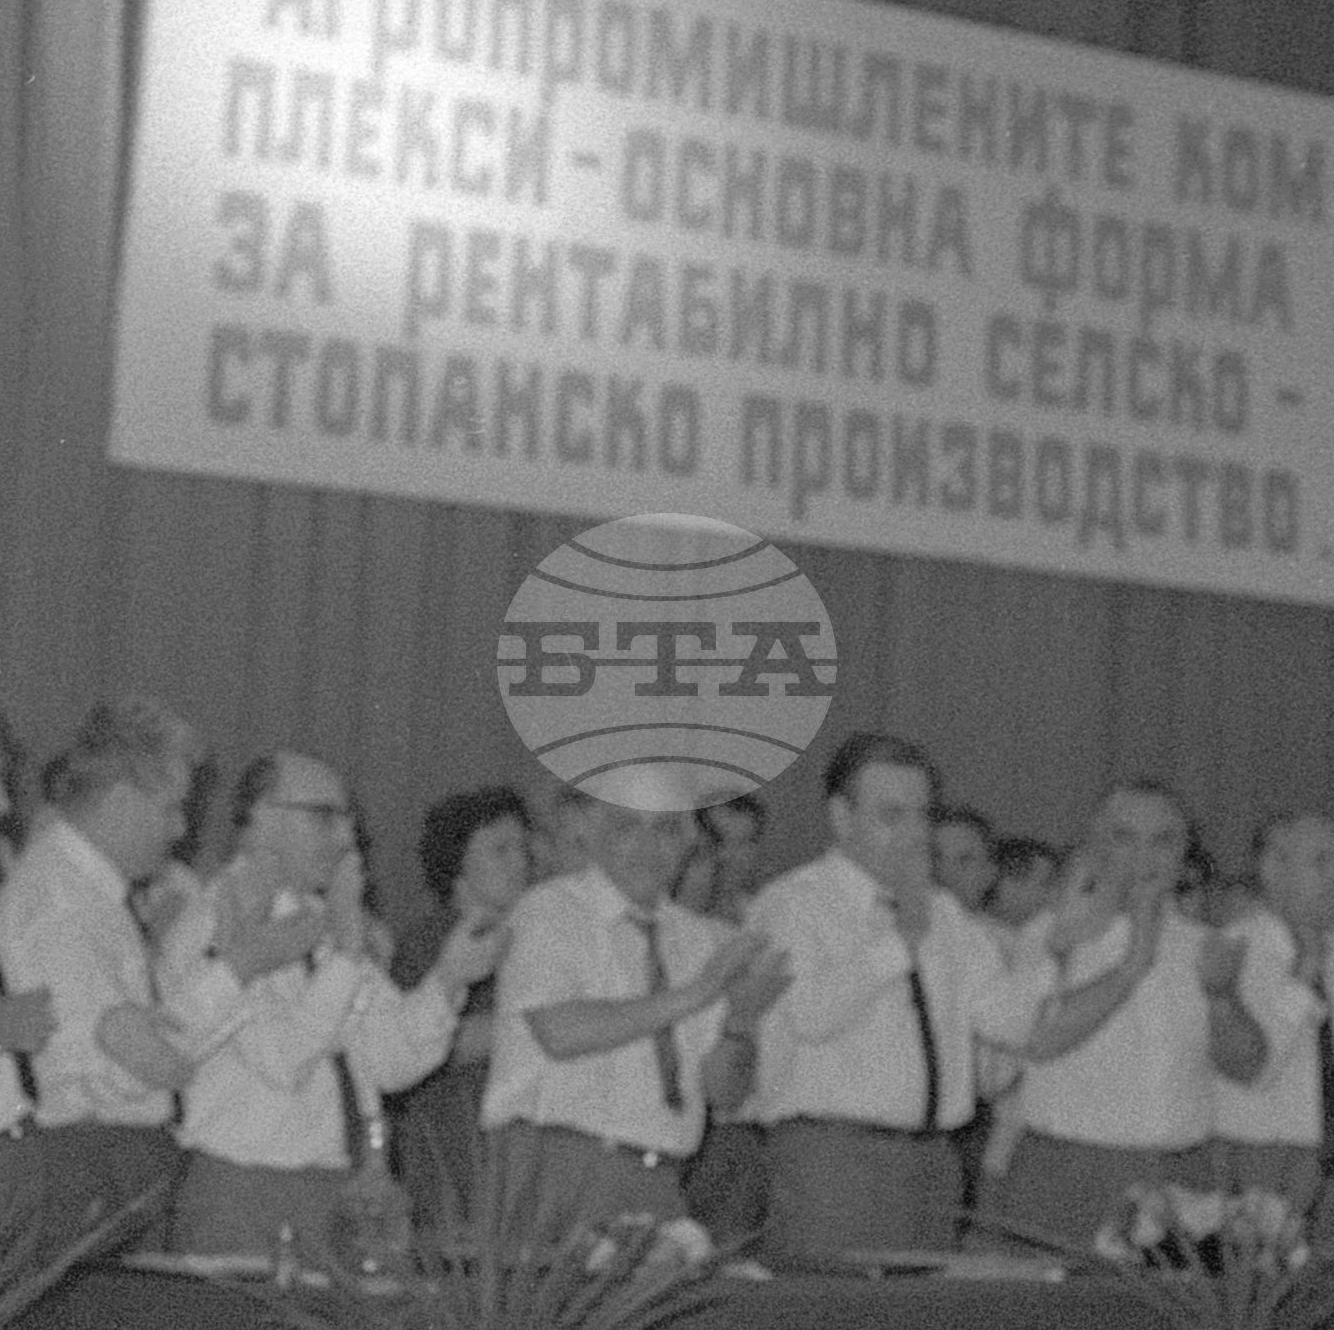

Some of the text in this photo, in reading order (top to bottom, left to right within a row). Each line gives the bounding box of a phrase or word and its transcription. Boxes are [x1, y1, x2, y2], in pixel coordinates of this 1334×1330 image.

[210, 188, 335, 307] ЗА
[403, 218, 939, 391] РЕНТАБИЛНО
[1018, 182, 1296, 336] ФОРМА
[205, 322, 1334, 558] СТОПАНСКО ПРОИЗВОДСТВО.
